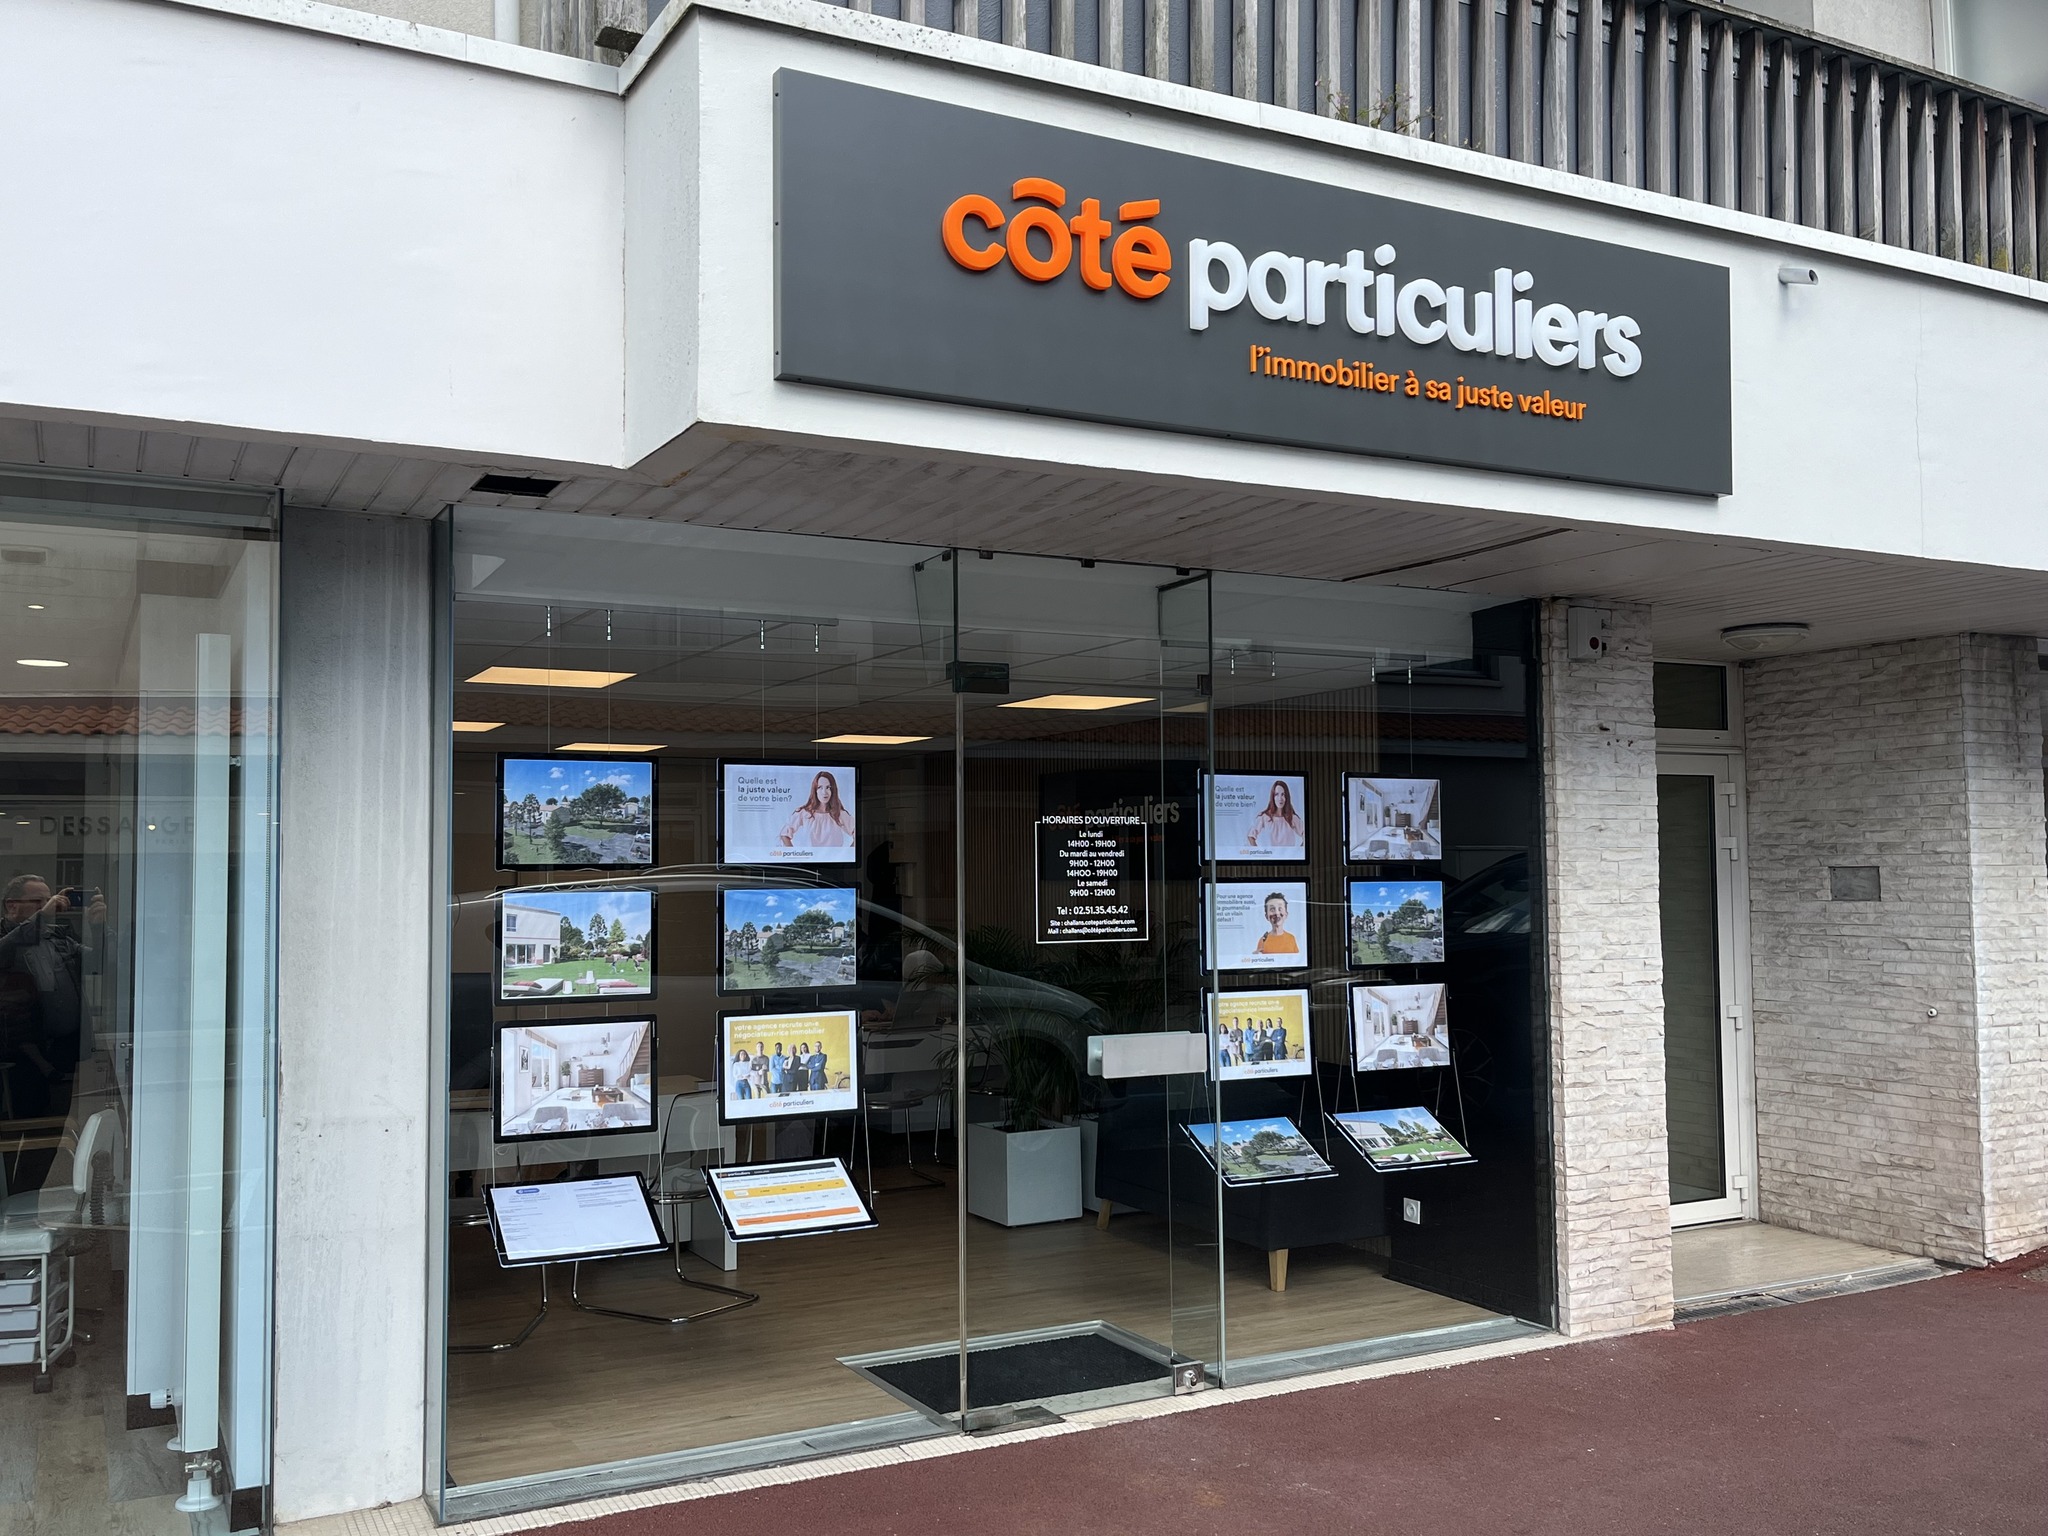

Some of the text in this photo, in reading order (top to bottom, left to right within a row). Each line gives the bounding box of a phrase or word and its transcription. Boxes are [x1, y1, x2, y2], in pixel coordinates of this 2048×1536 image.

[942, 177, 1642, 377] côté particuliers
[1250, 344, 1587, 420] l'immobilier à sa juste valeur
[737, 776, 777, 785] Quelle est
[738, 785, 791, 795] la juste valeur
[772, 794, 793, 802] bien?
[1042, 816, 1141, 825] HORAIRES D'OUVERTURE
[1067, 840, 1090, 848] 14H00
[1096, 869, 1118, 877] 19H00
[1077, 879, 1085, 887] Le
[1069, 889, 1089, 897] 9H00
[1056, 906, 1067, 915] Tel
[1073, 905, 1129, 915] 02.51.35.45.42
[734, 1024, 752, 1032] votre
[753, 1023, 778, 1031] agence
[779, 1021, 803, 1029] recrute
[790, 1027, 825, 1036] immobilier
